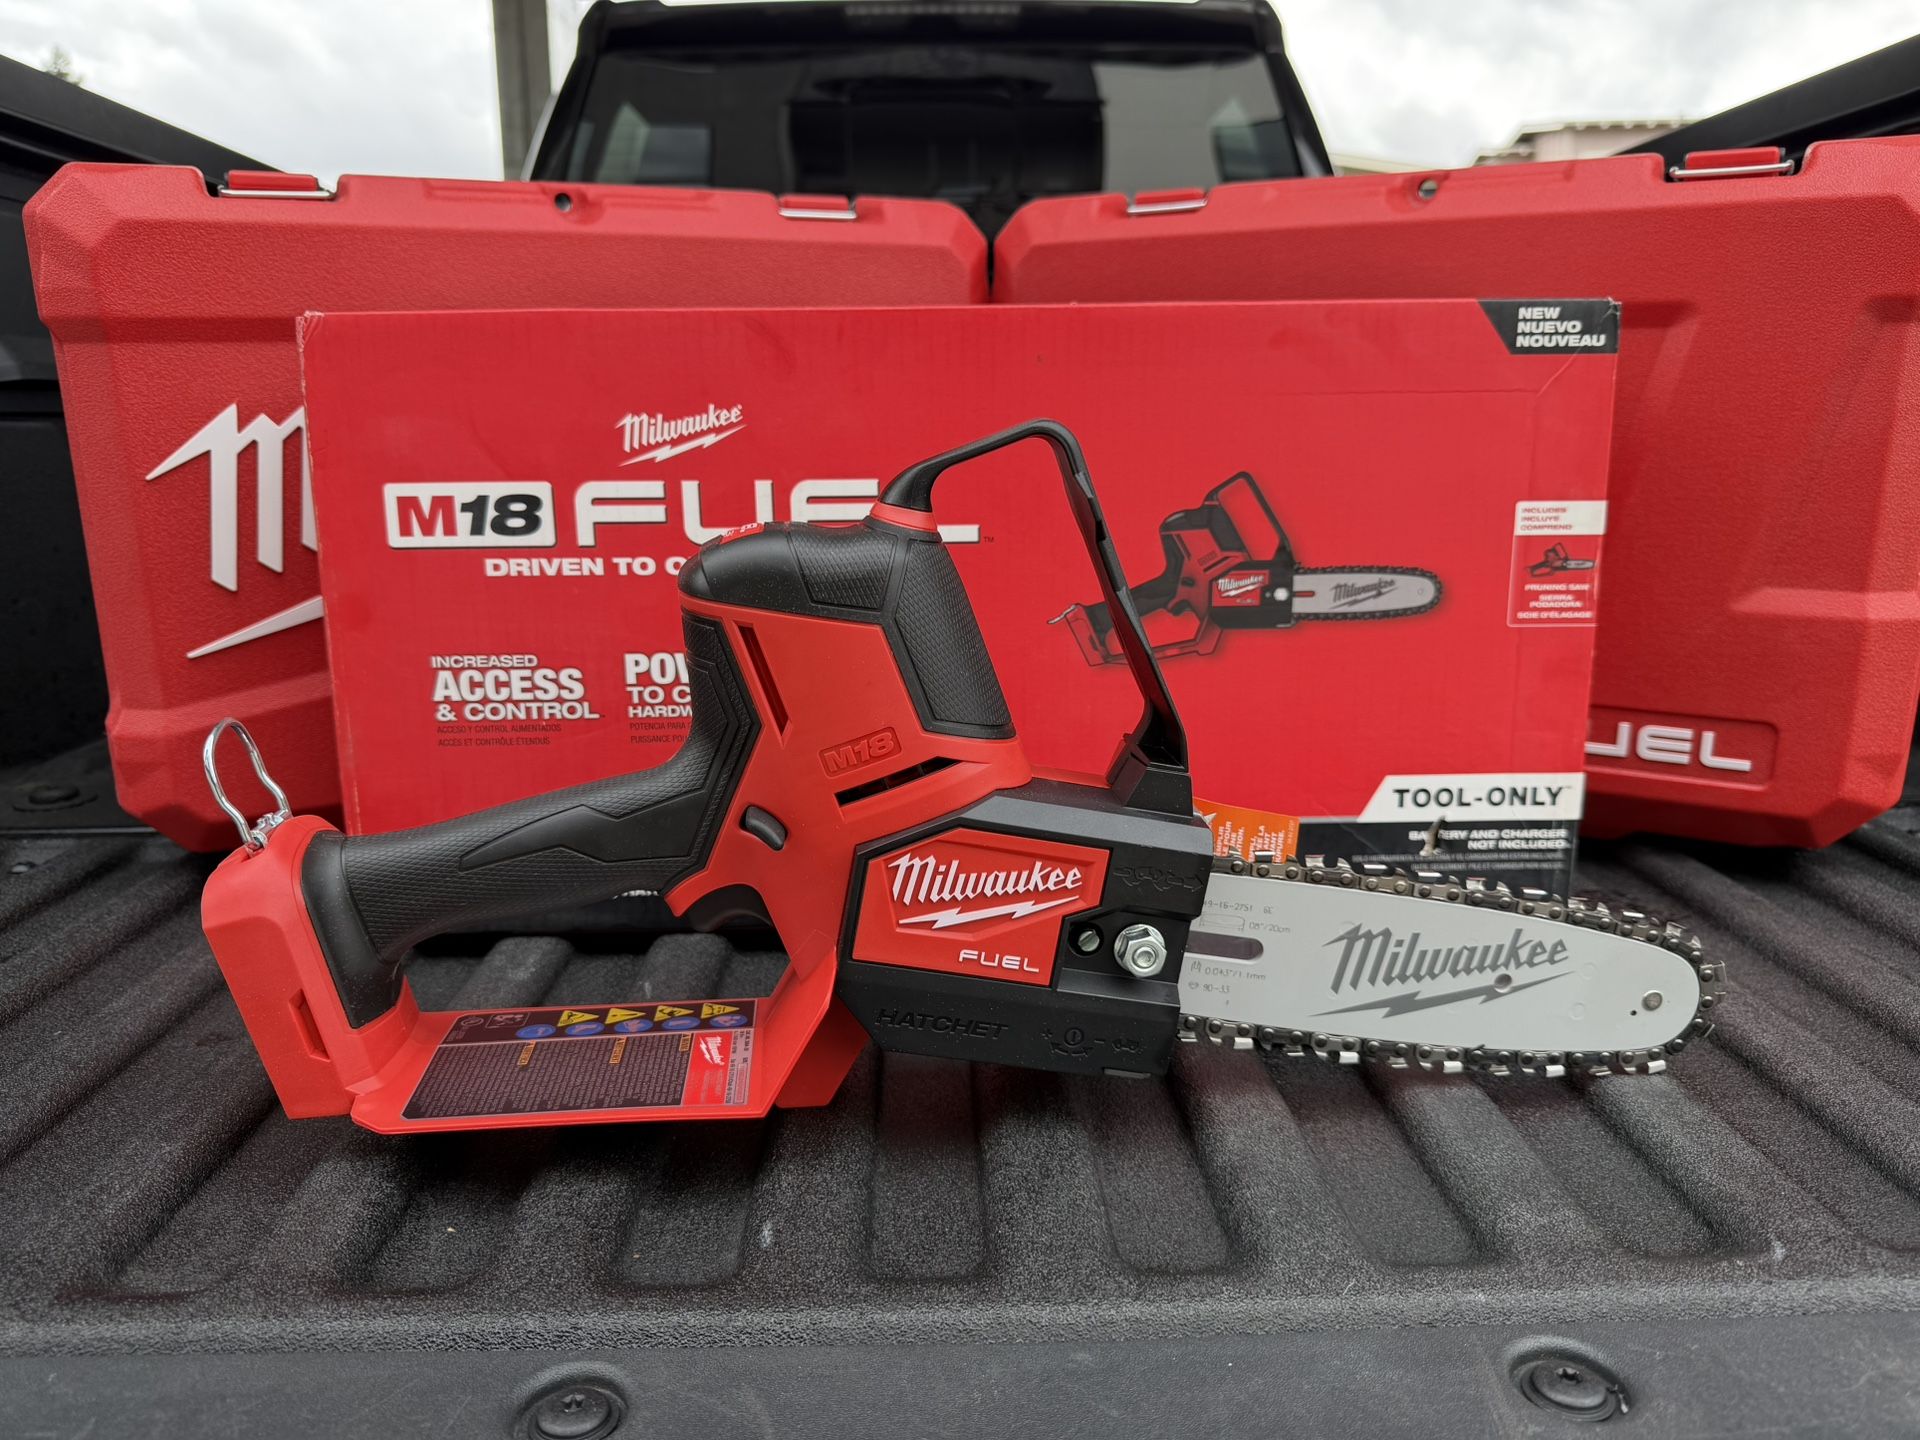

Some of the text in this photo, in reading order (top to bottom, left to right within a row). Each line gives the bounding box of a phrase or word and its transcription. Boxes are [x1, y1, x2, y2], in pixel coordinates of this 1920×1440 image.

[1518, 307, 1560, 320] NEW
[1517, 320, 1582, 333] NUEVO
[1516, 334, 1607, 348] NOUVEAU
[614, 403, 744, 453] Milwaukee
[396, 478, 981, 548] M18 FUE
[484, 558, 605, 577] DRIVEN
[612, 557, 657, 576] TO
[431, 655, 538, 668] INCREASED
[433, 668, 585, 701] ACCESS
[626, 685, 666, 705] TO
[436, 702, 600, 721] & CONTROL
[437, 724, 468, 734] ACCESO
[474, 723, 510, 733] CONTROL
[823, 731, 895, 773] M18
[1393, 785, 1563, 808] TOOL-ONLY
[1408, 828, 1569, 841] BAERY AND CHARGER
[1467, 840, 1498, 850] NOT
[886, 851, 1084, 907] Milwaukee
[958, 949, 1040, 974] FUEL
[1321, 922, 1570, 996] Milwaukee
[874, 1008, 1010, 1041] HATCHET
